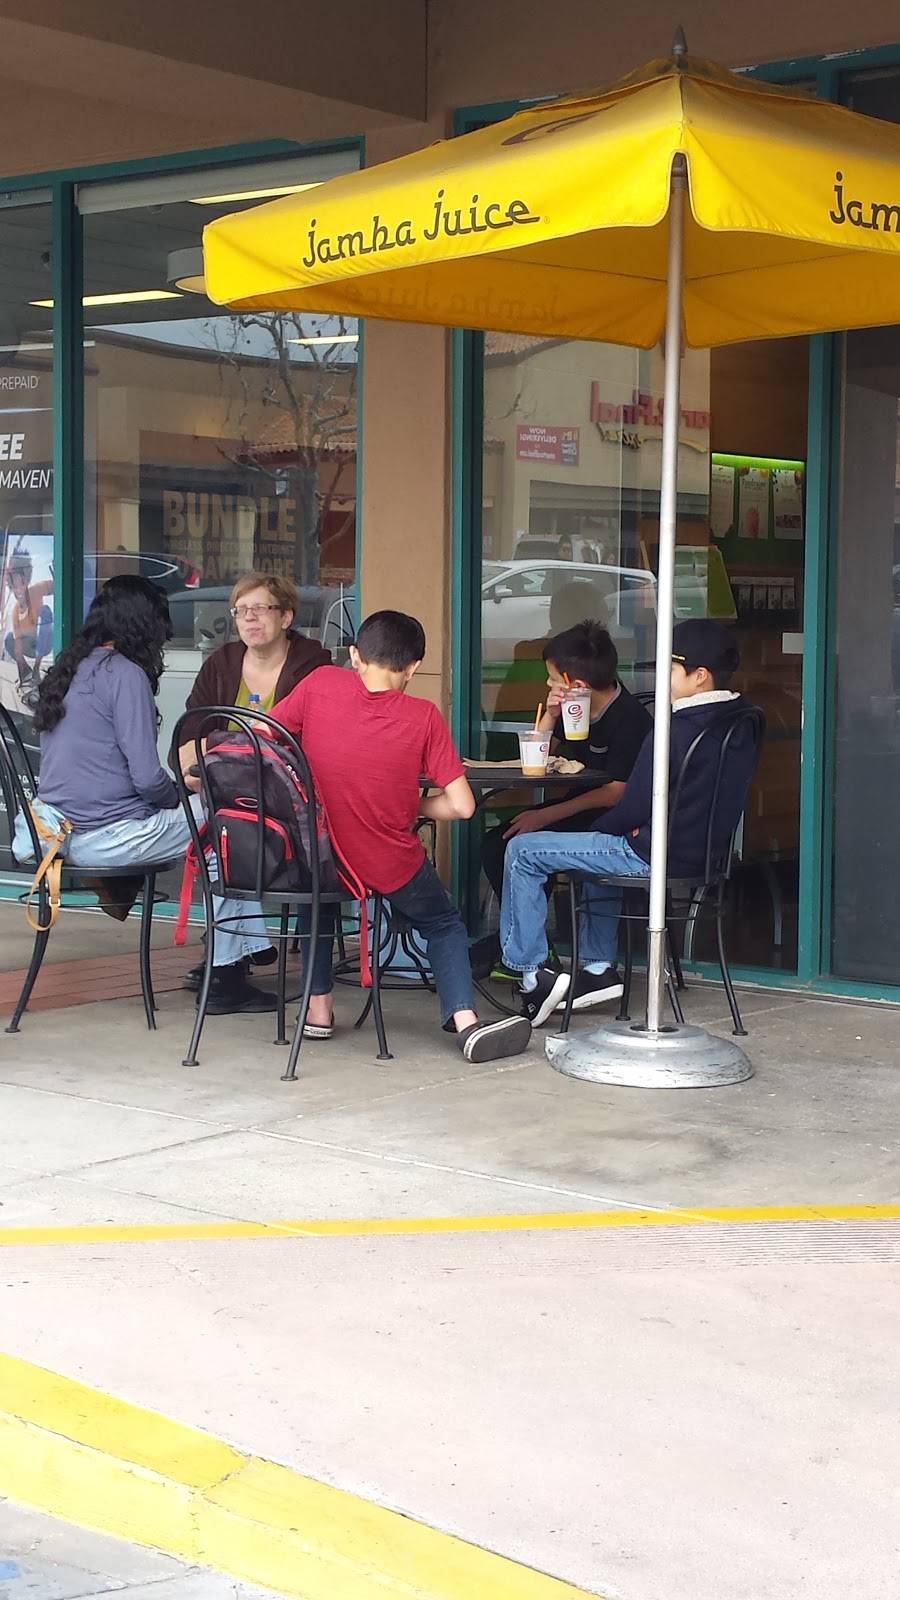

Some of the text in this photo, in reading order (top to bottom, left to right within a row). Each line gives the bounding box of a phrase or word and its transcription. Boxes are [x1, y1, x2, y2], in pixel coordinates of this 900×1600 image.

[302, 189, 541, 268] jamba juice
[163, 490, 297, 542] BUNDLE
